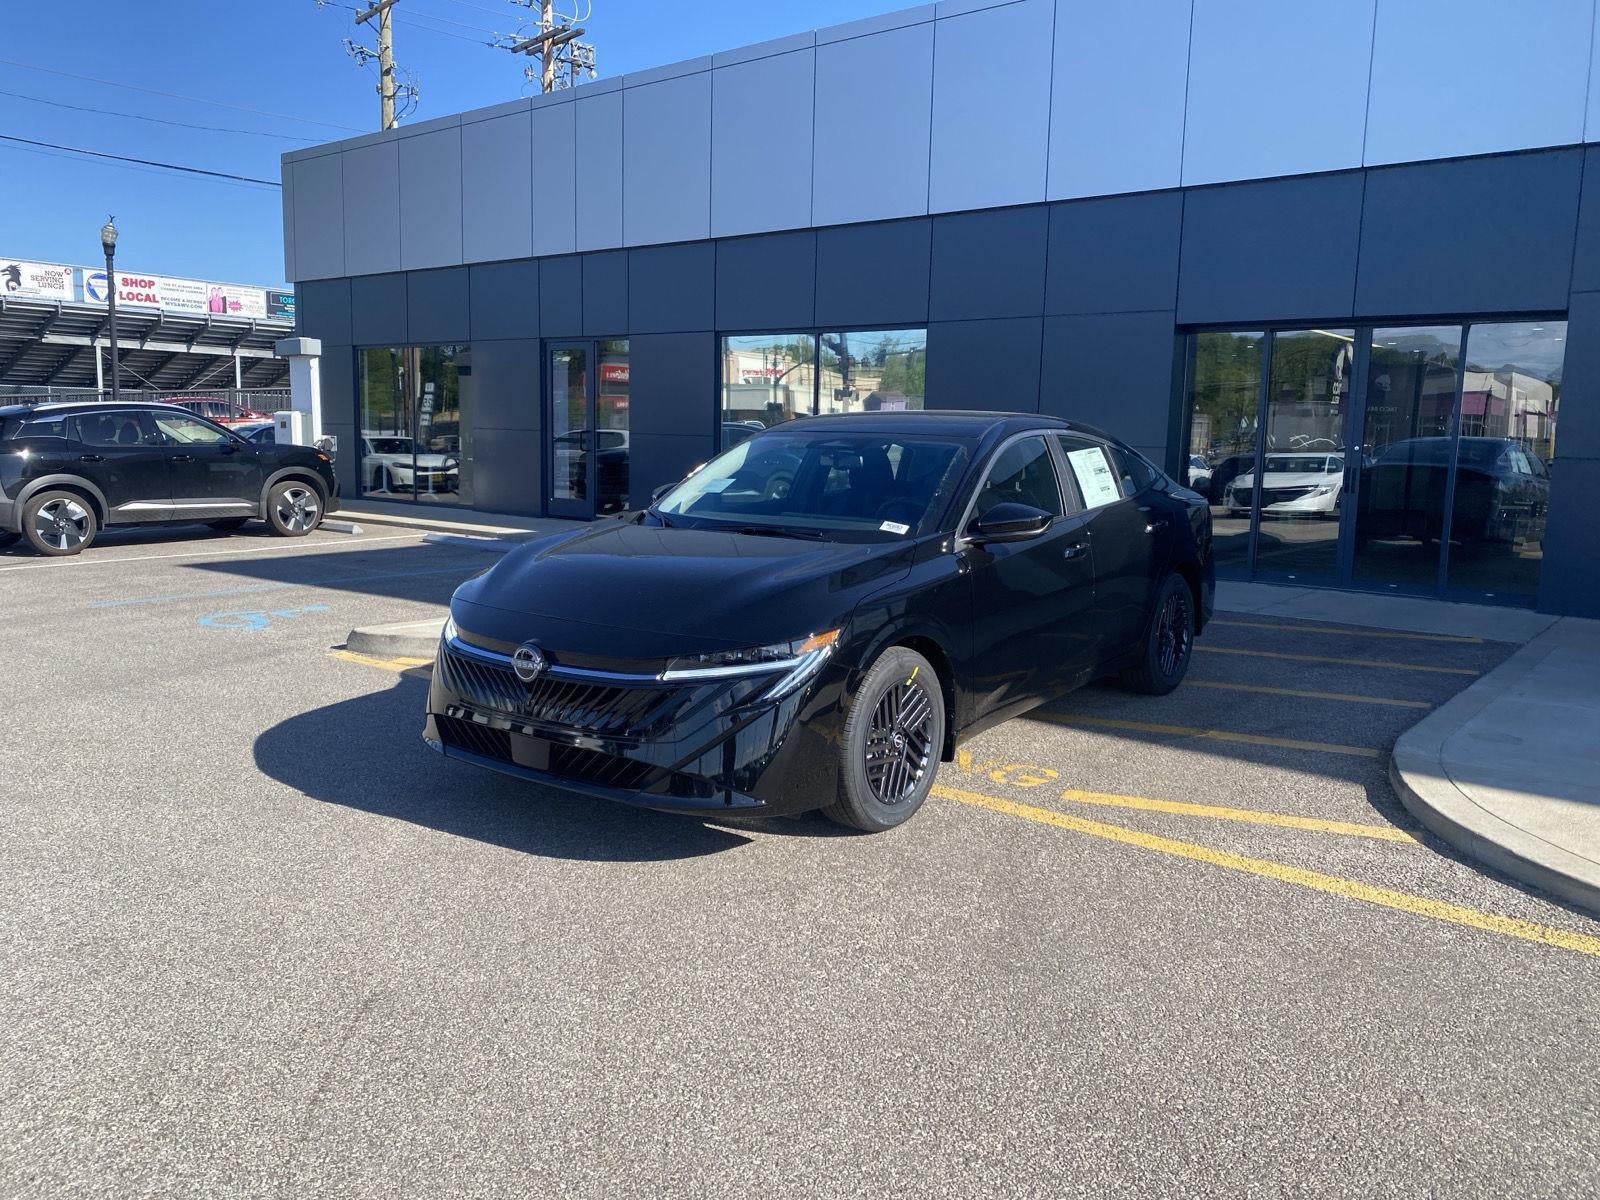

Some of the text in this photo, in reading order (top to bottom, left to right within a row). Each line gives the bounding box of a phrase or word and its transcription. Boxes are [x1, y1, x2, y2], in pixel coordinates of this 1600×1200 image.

[30, 275, 64, 284] SERVING
[121, 277, 155, 289] SHOP
[38, 281, 64, 290] LUNCH
[119, 291, 159, 303] LOCAL
